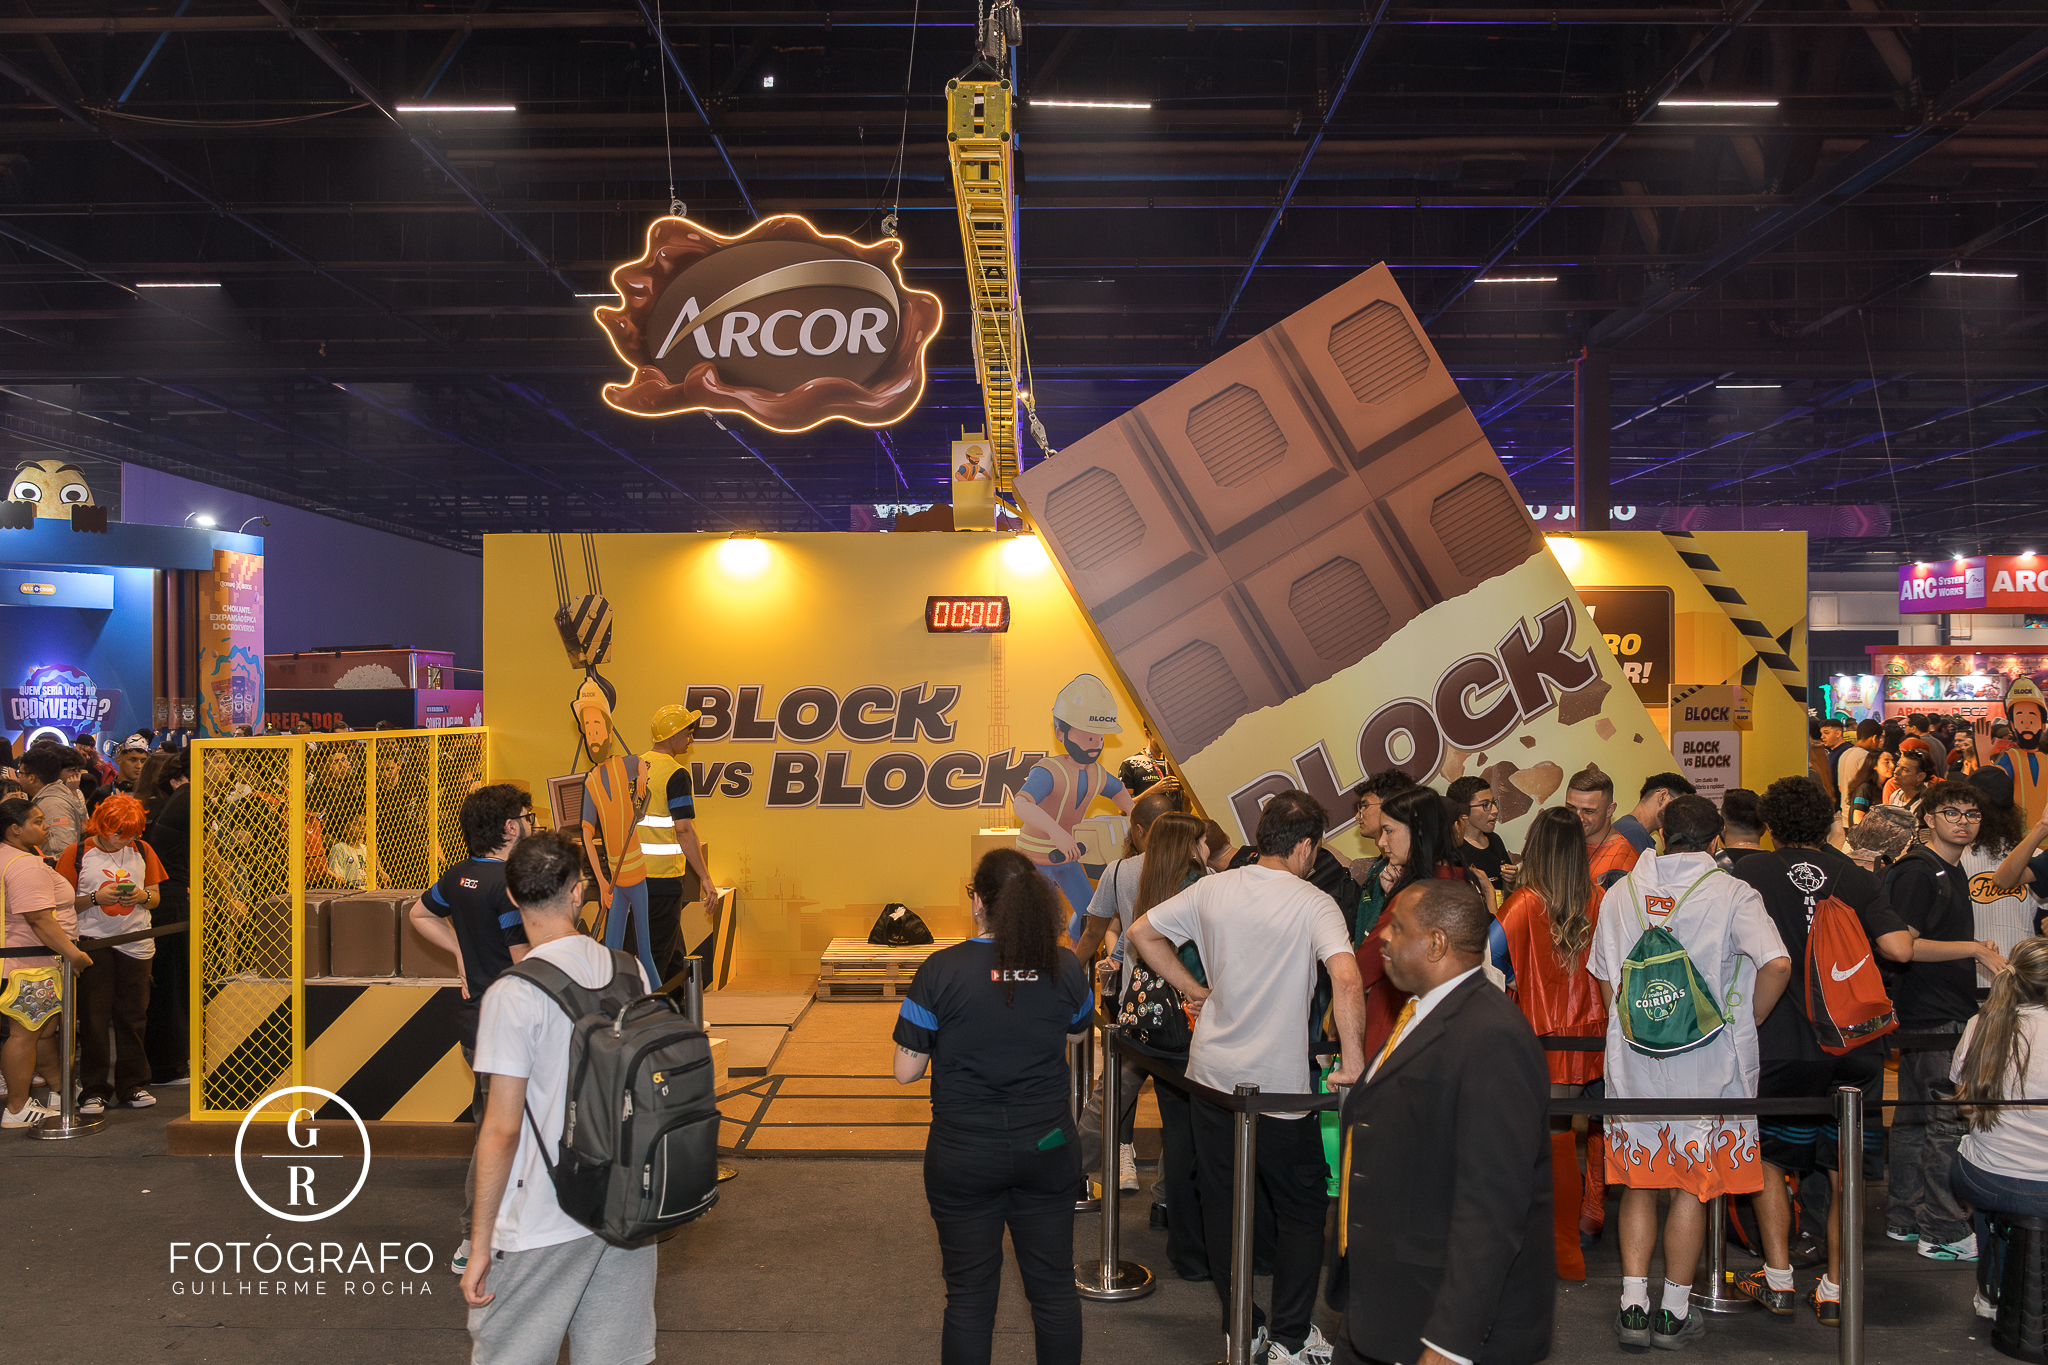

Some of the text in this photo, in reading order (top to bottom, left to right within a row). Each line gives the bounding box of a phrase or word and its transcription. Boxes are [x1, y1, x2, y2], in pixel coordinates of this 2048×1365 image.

[655, 296, 889, 360] ARCOR
[1901, 577, 1938, 601] ARC
[1938, 586, 1965, 597] WORKS
[933, 601, 1002, 627] 00:00
[213, 623, 226, 631] DO
[1602, 633, 1642, 656] RO
[1622, 661, 1653, 684] R!
[19, 683, 96, 696] QUEM SERIA VOCÊ NO
[11, 697, 111, 721] CROKVERSO?
[684, 682, 962, 743] BLOCK
[1089, 715, 1117, 723] BLOCK
[1684, 705, 1730, 722] BLOCK
[1683, 741, 1720, 755] BLOCK
[1694, 755, 1731, 769] BLOCK
[764, 747, 1049, 809] BLOCK
